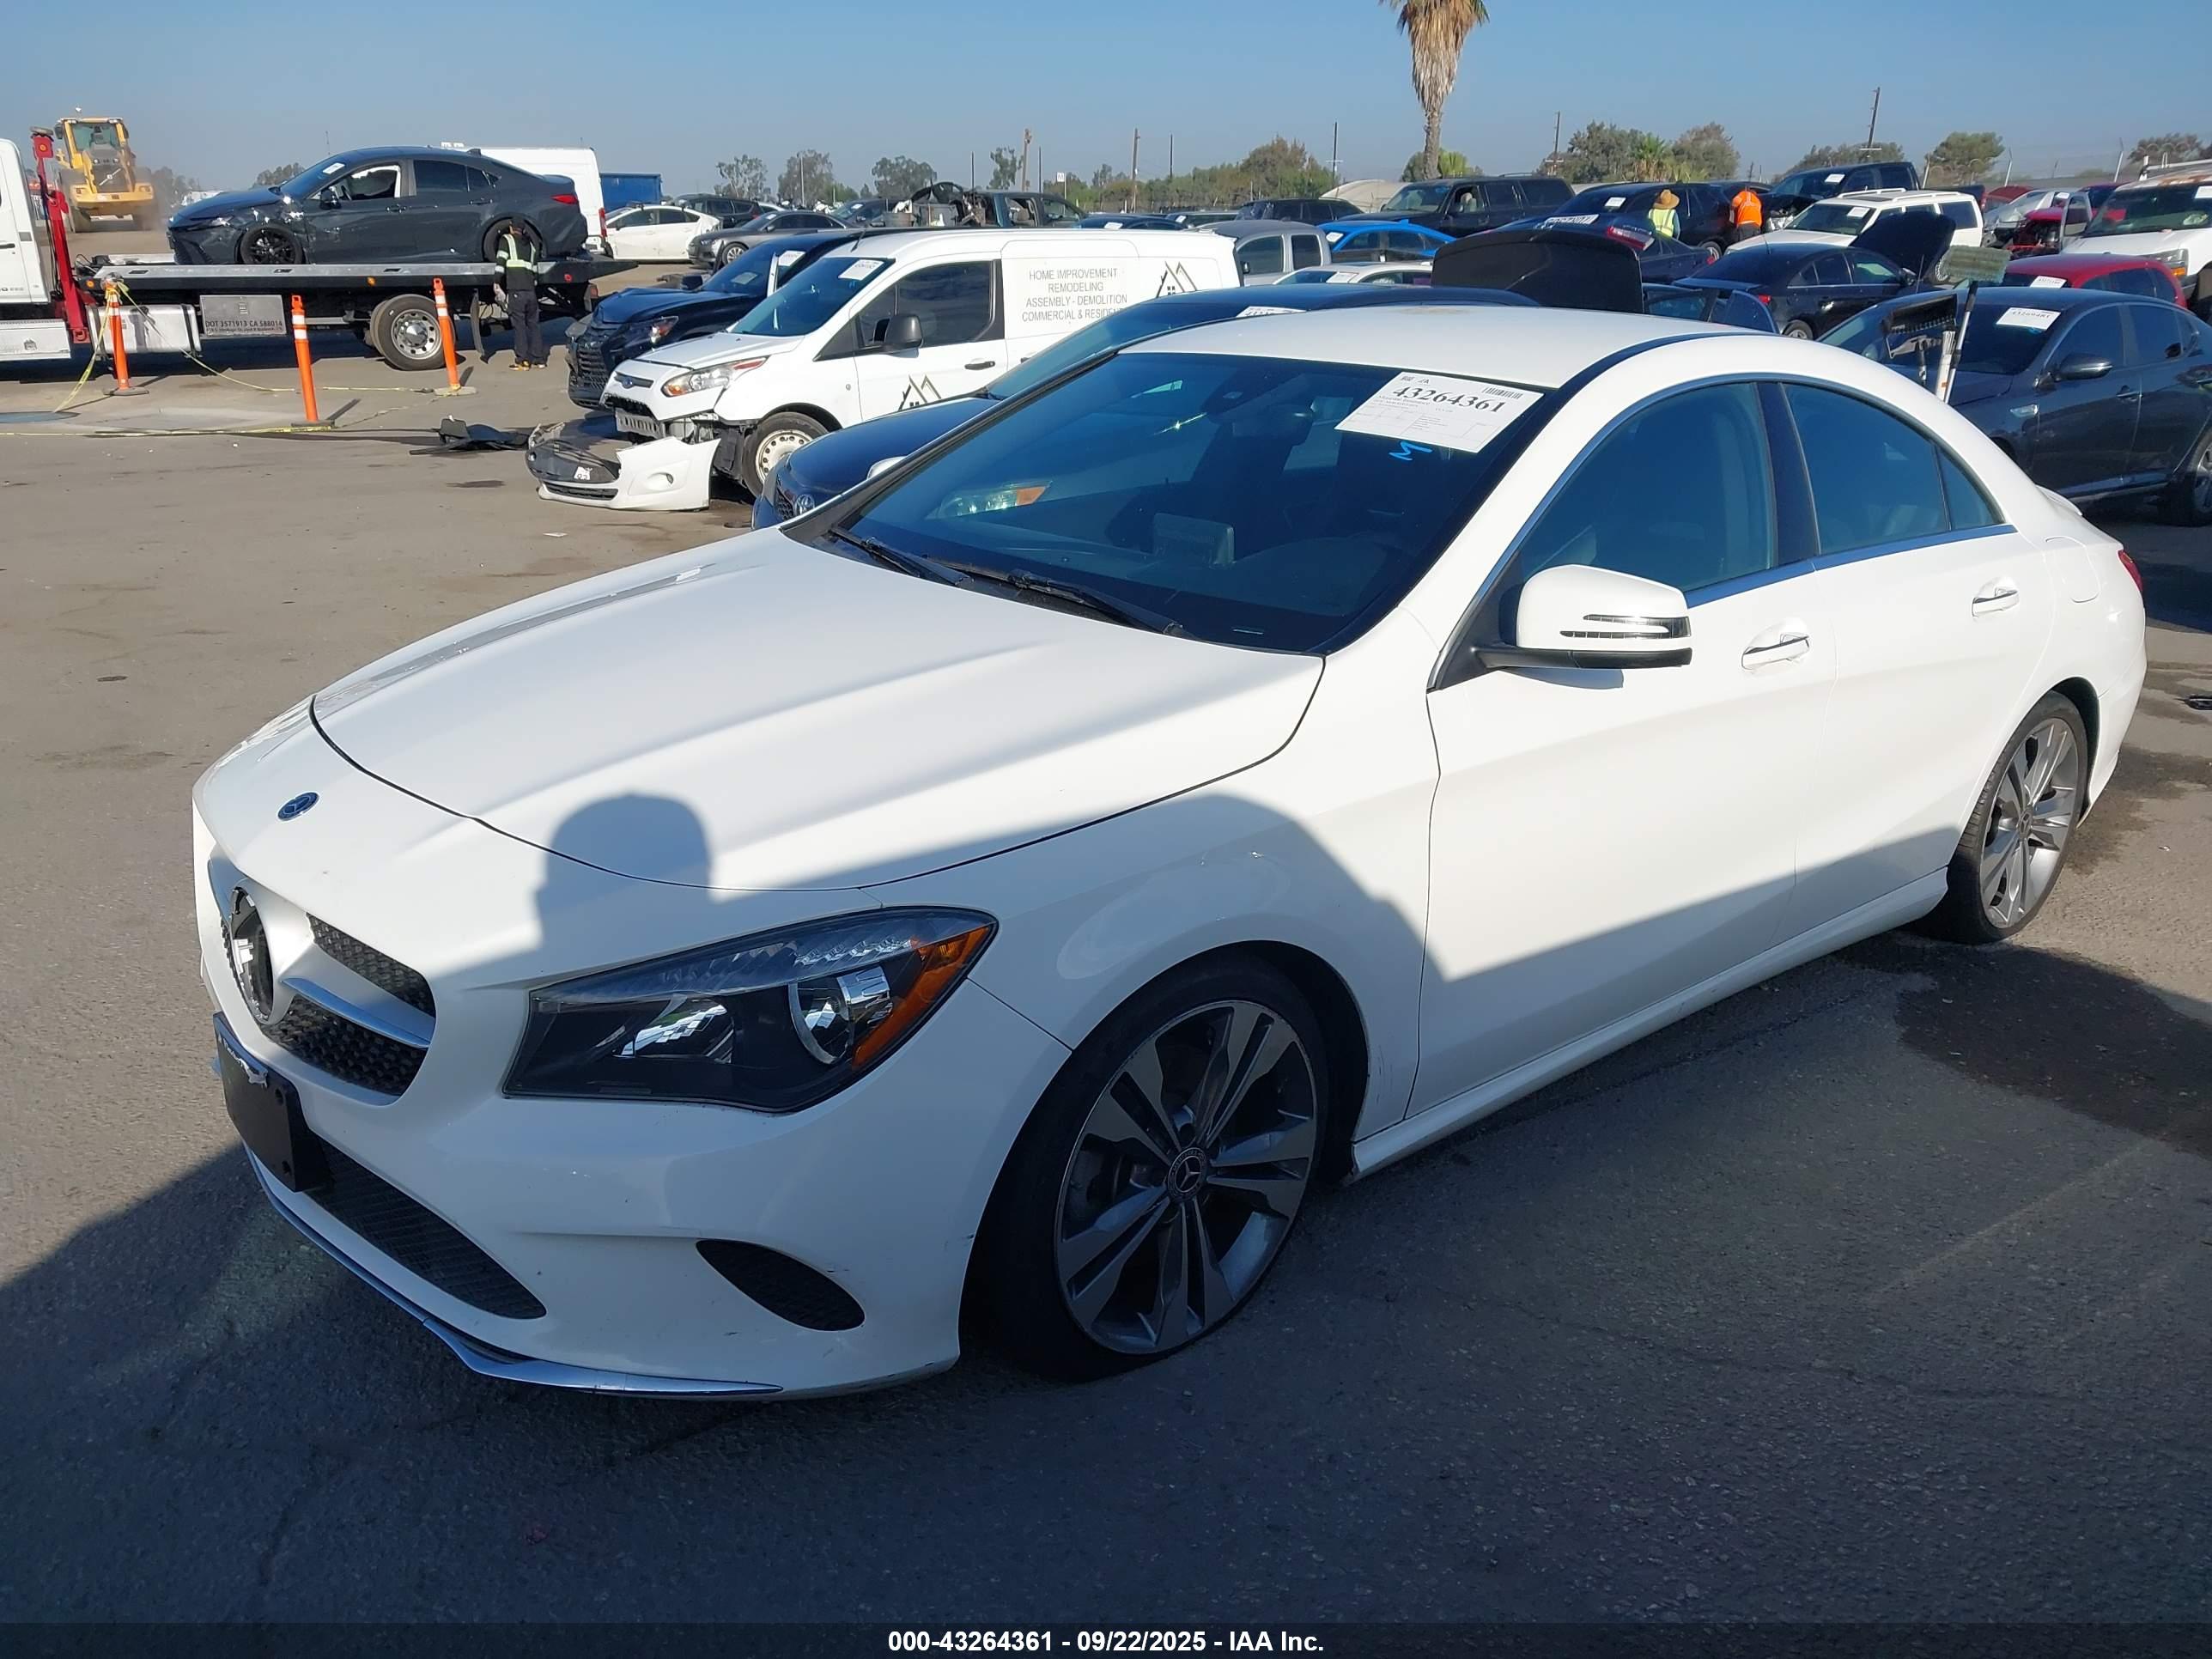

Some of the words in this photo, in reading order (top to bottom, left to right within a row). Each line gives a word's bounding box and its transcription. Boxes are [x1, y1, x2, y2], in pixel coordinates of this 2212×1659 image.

[1029, 270, 1055, 280] HOME
[1057, 268, 1118, 279] IMPROVEMENT
[1048, 282, 1103, 293] REMODELING
[1026, 296, 1071, 307] ASSEMBLY
[1077, 294, 1127, 306] DEMOLITION
[1022, 310, 1075, 322] COMMERCIAL
[1078, 308, 1083, 319] &
[1393, 386, 1506, 413] 43264361
